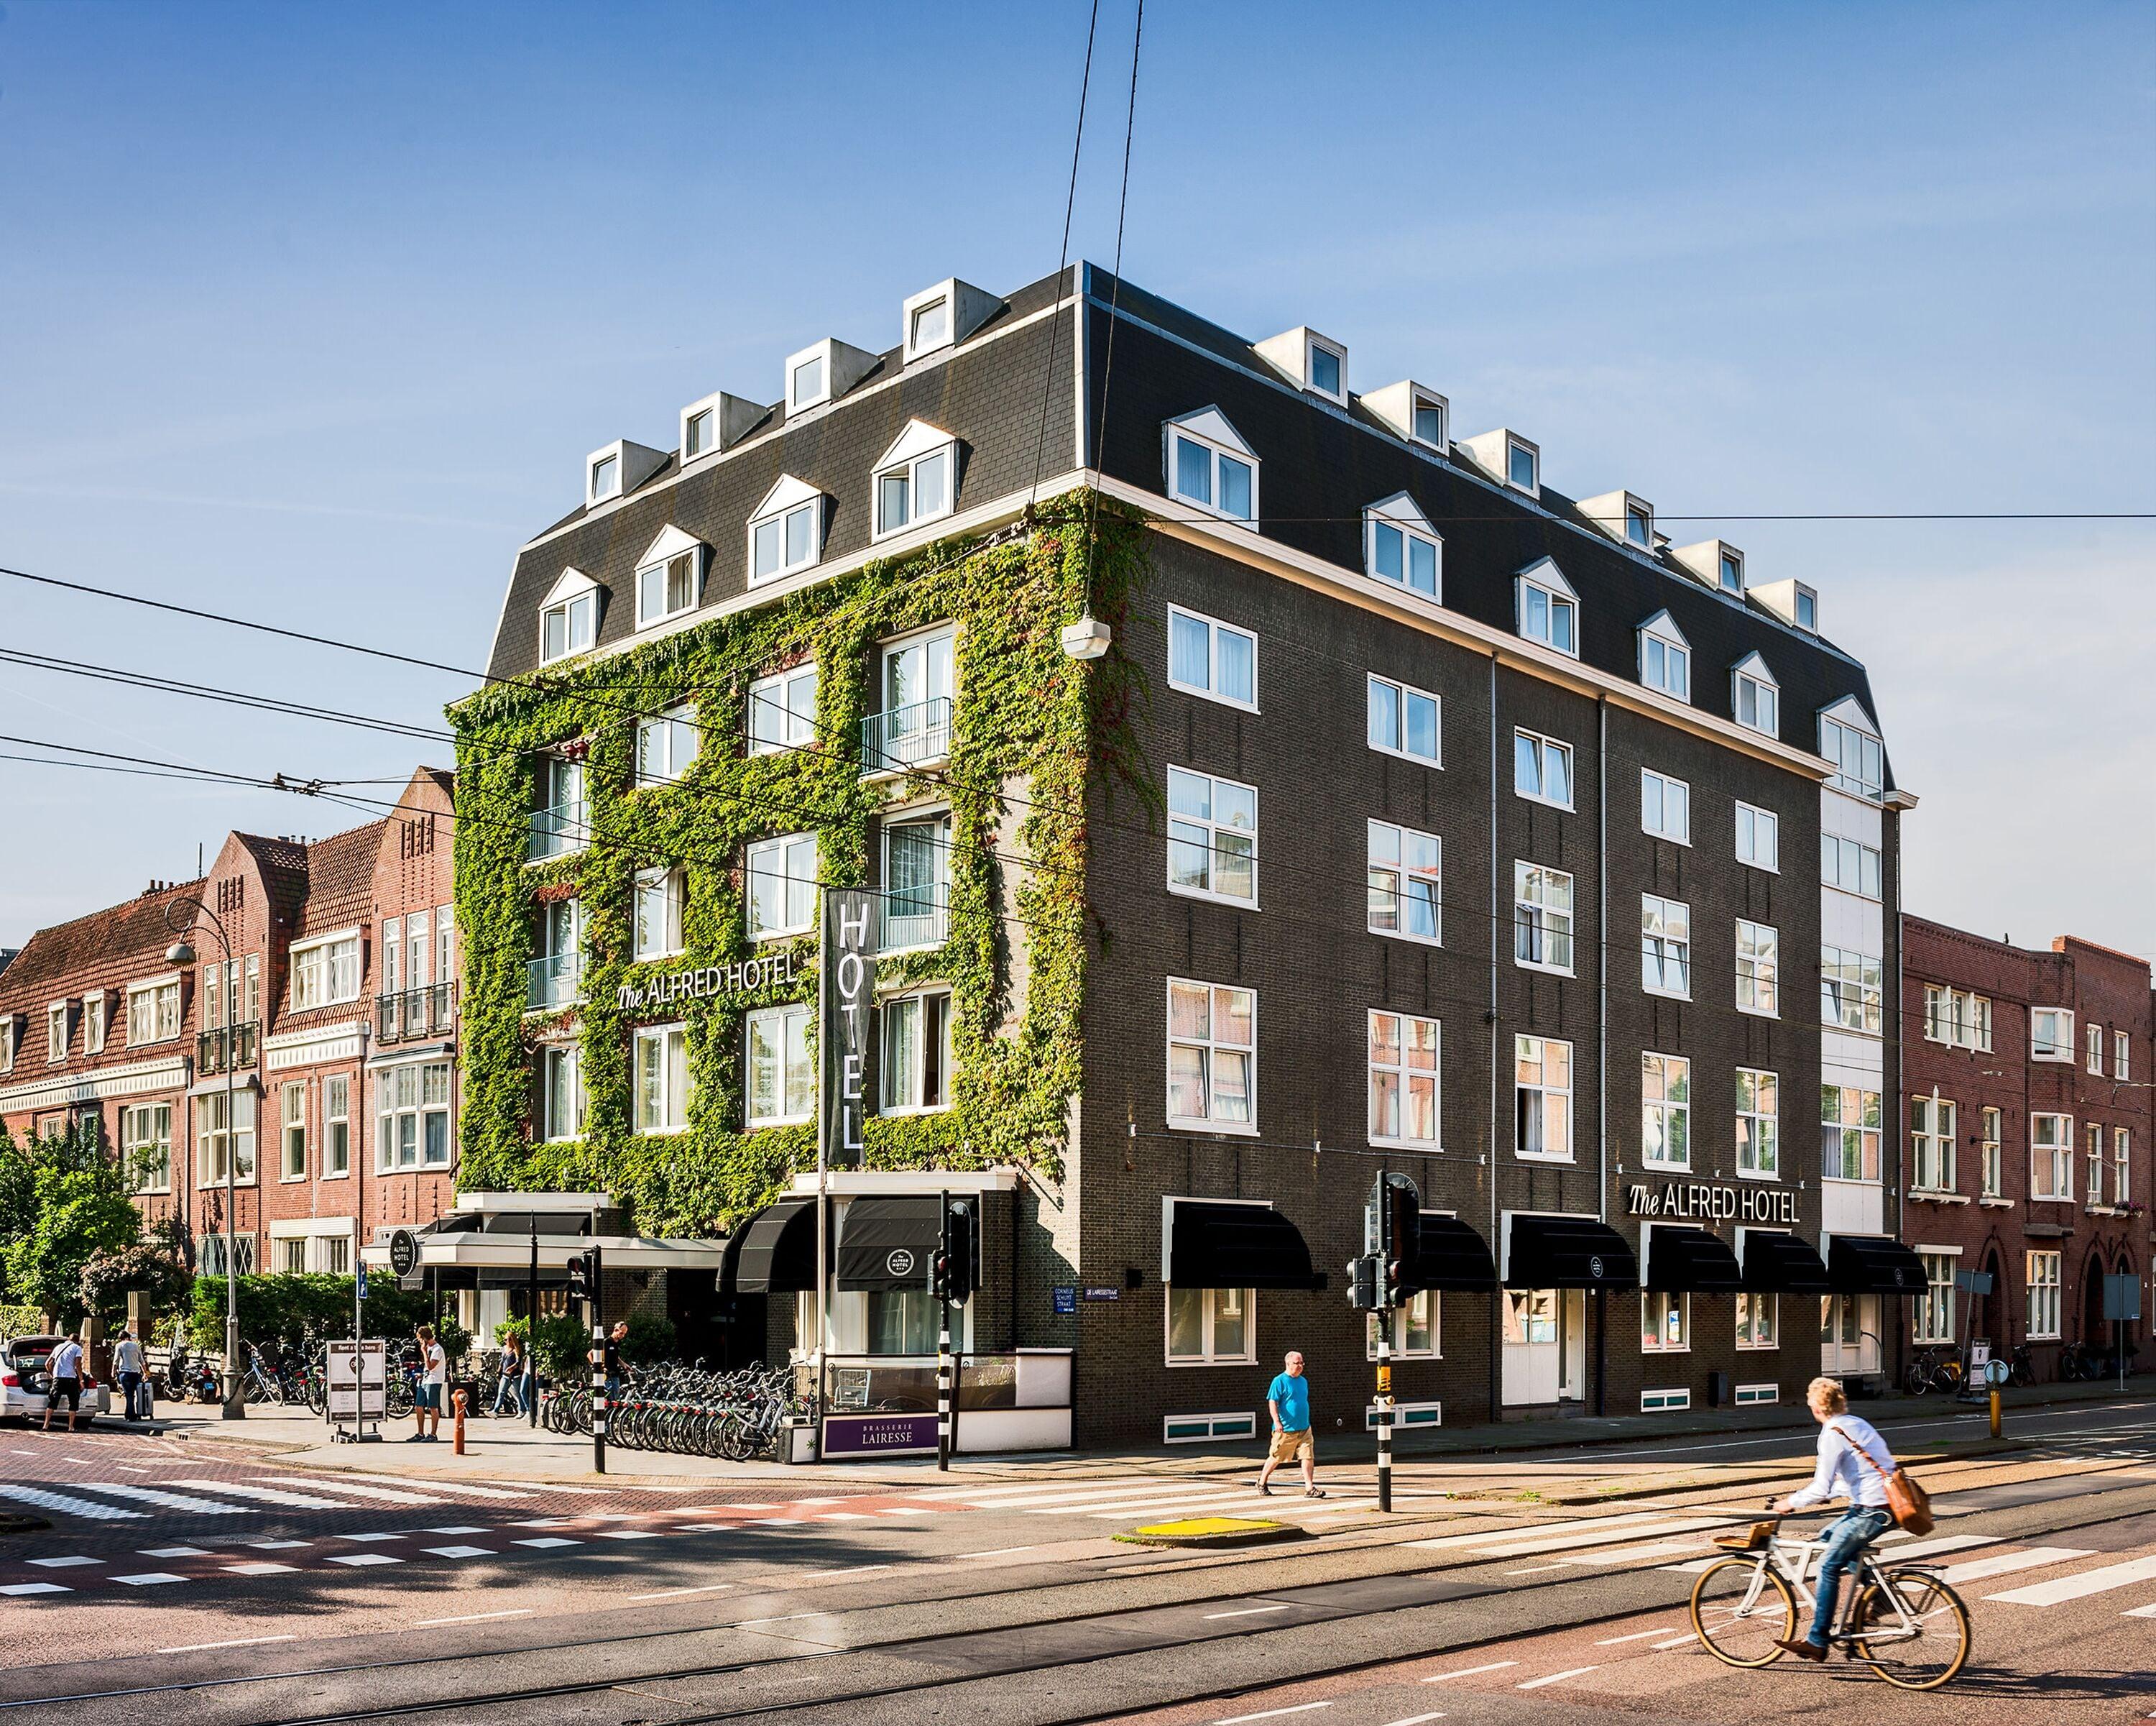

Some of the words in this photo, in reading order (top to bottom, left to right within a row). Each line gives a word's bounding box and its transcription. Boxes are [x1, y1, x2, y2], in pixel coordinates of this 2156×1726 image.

[617, 985, 643, 1009] The
[647, 967, 721, 1004] ALFRED
[728, 954, 798, 992] HOTEL
[838, 903, 868, 1149] HOTEL
[1629, 1185, 1659, 1215] The
[1663, 1183, 1736, 1218] ALFRED
[1742, 1188, 1800, 1222] HOTEL
[862, 1432, 913, 1445] LAIRESSE
